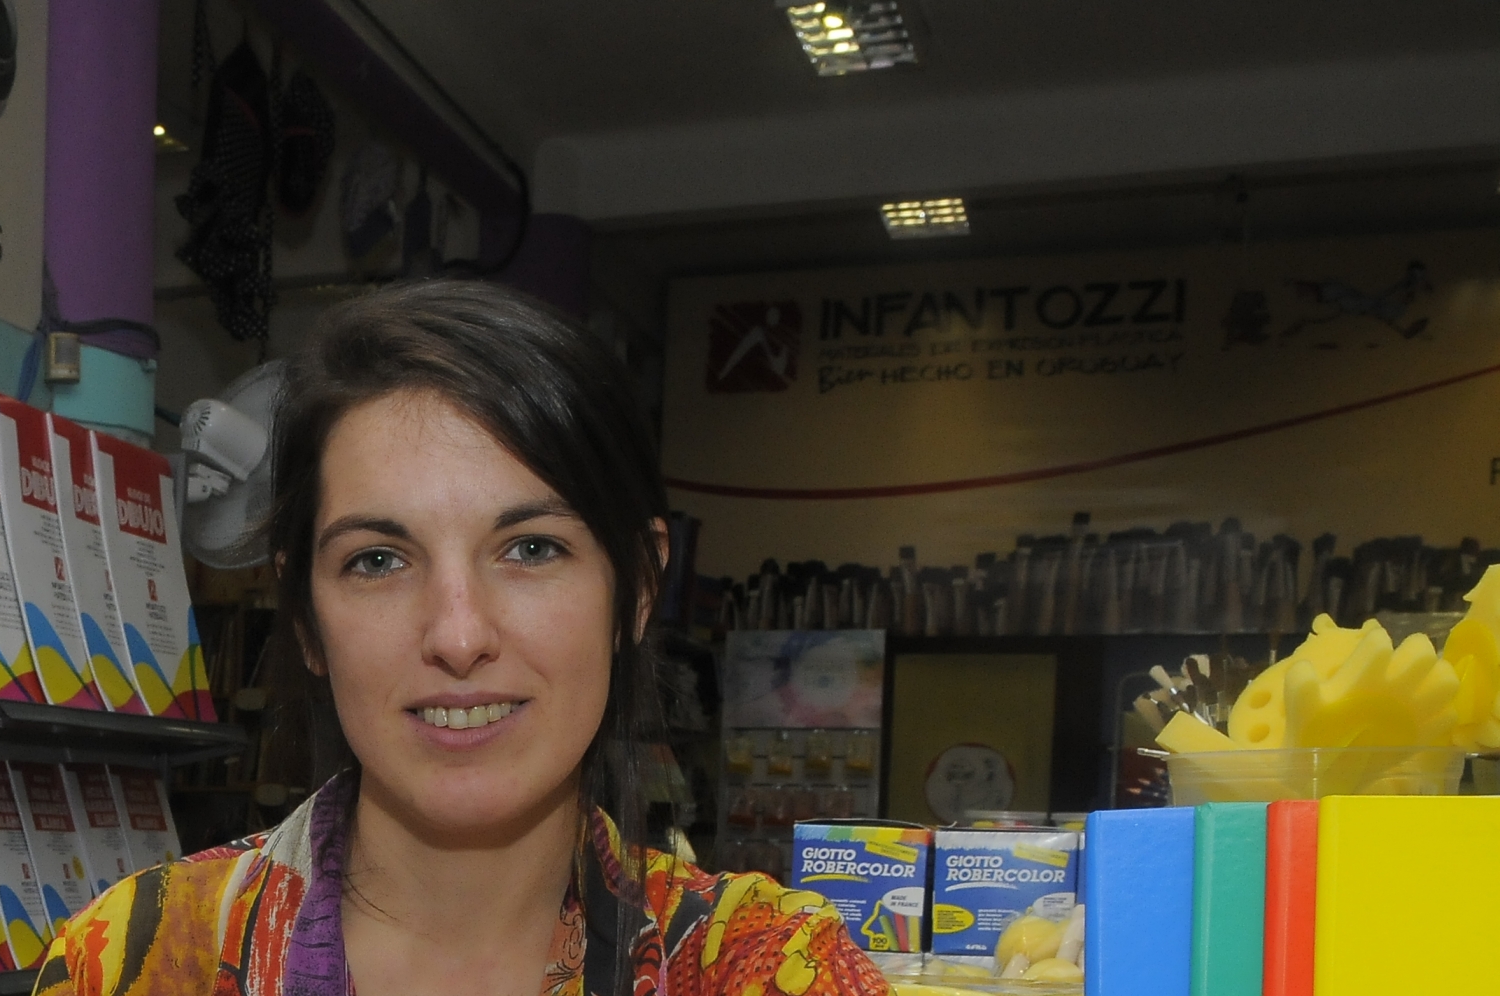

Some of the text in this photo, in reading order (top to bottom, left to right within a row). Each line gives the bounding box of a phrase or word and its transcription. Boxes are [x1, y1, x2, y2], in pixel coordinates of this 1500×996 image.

[818, 280, 1187, 340] INFANTOZZI
[880, 362, 974, 386] HECHO
[987, 359, 1026, 380] EN
[1035, 352, 1186, 379] URUGUAY
[21, 467, 57, 506] DIBU
[118, 498, 166, 537] DIBUJO
[802, 847, 856, 861] GIOTTO
[946, 855, 1003, 868] GIOTTO
[801, 860, 916, 878] ROBERCOLOR
[946, 868, 1066, 883] ROBERCOLOR
